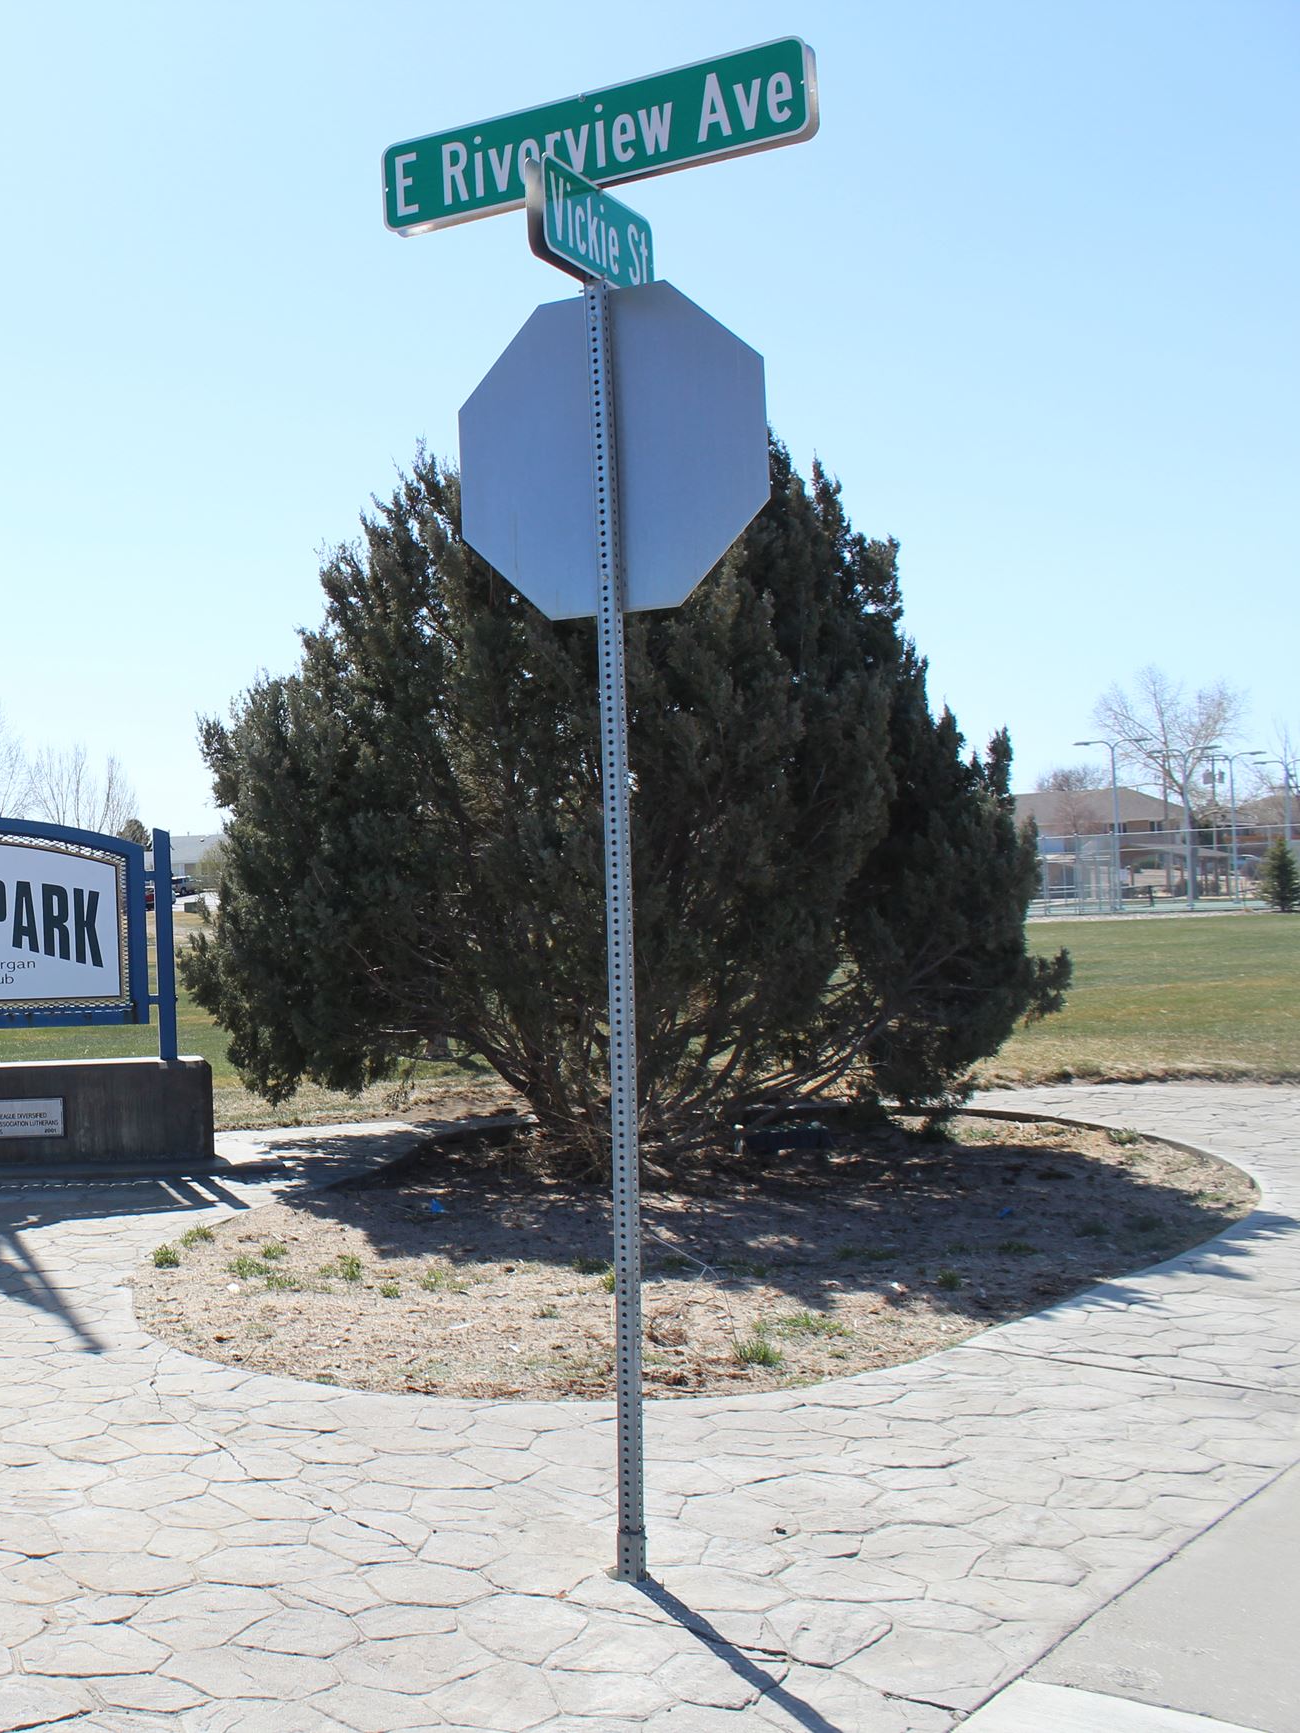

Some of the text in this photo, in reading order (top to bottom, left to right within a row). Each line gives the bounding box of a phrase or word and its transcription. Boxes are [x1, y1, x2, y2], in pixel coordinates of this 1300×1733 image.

[394, 152, 420, 217] E
[697, 72, 794, 144] Ave
[550, 171, 649, 285] Vickie St
[17, 1111, 48, 1119] DIVERSIFIED
